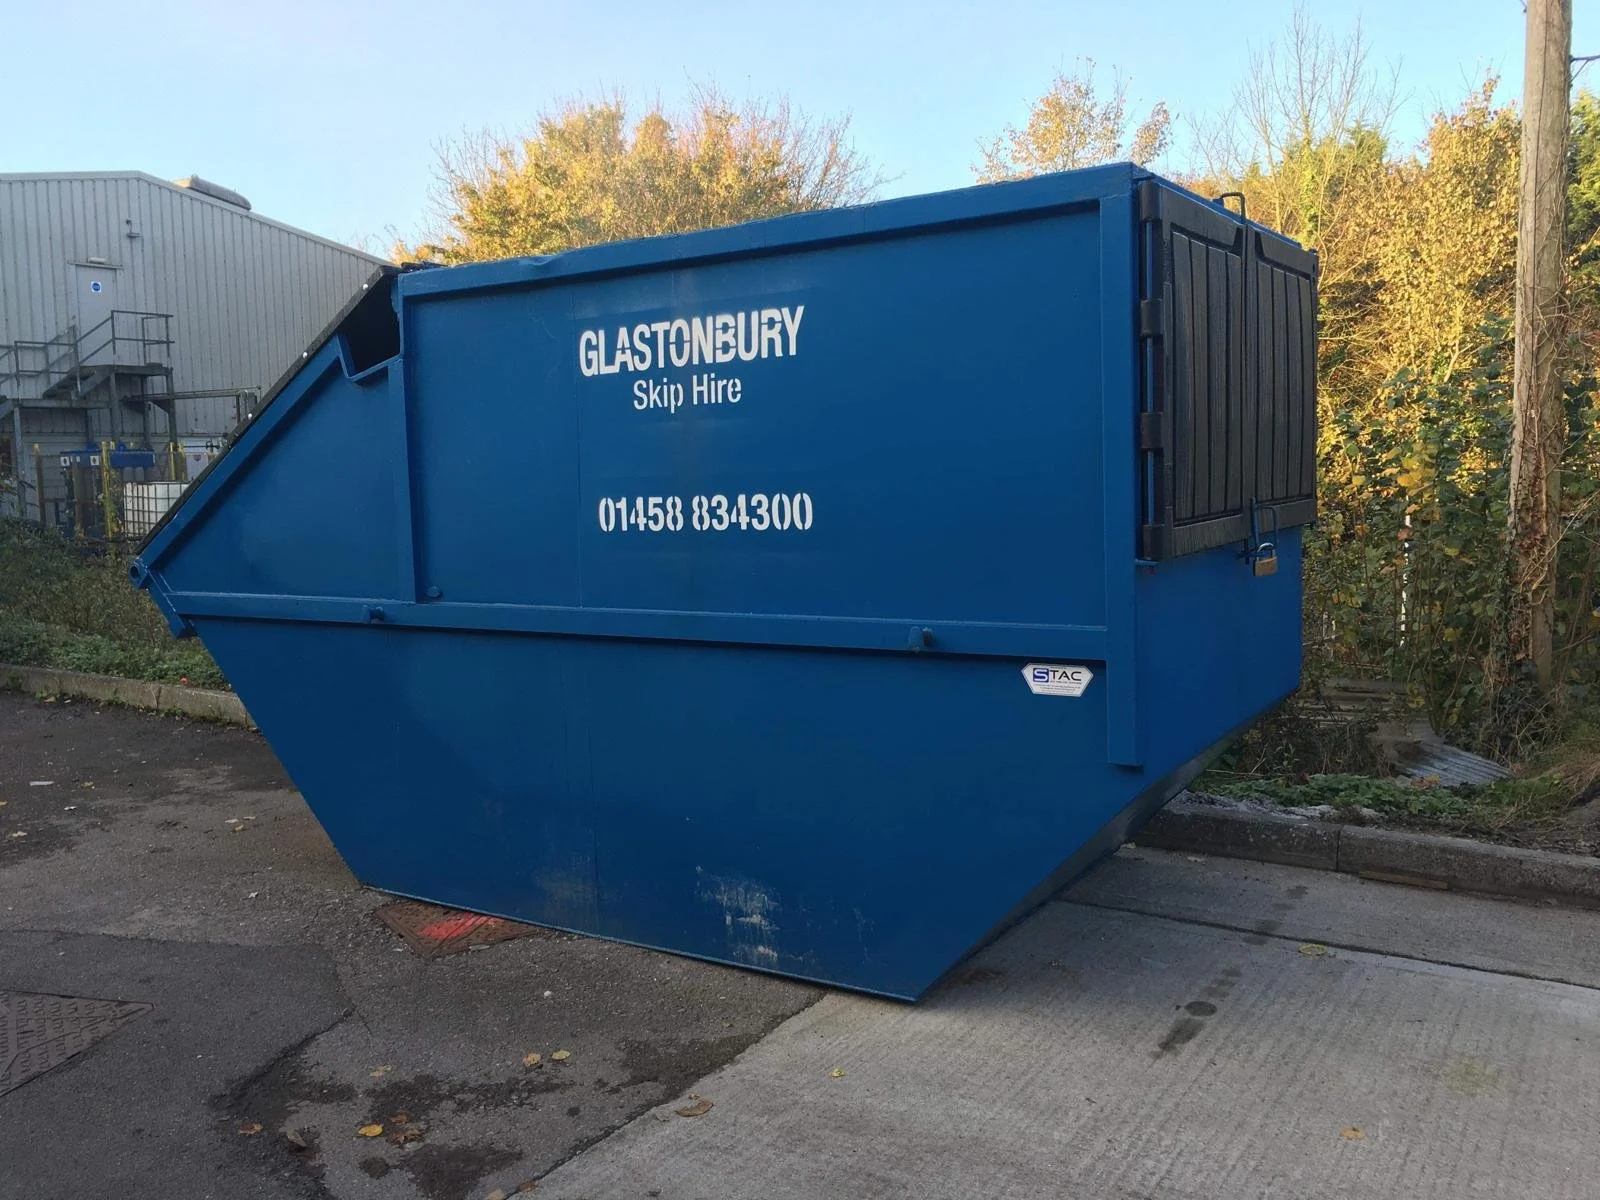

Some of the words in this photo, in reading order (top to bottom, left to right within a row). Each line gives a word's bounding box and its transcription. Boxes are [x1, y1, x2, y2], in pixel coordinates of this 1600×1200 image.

[579, 305, 805, 377] GLASTONBURY
[633, 377, 684, 414] Skip
[692, 372, 742, 405] Hire
[599, 495, 684, 532] 01458
[692, 492, 813, 531] 834300
[1033, 668, 1082, 682] STAC
